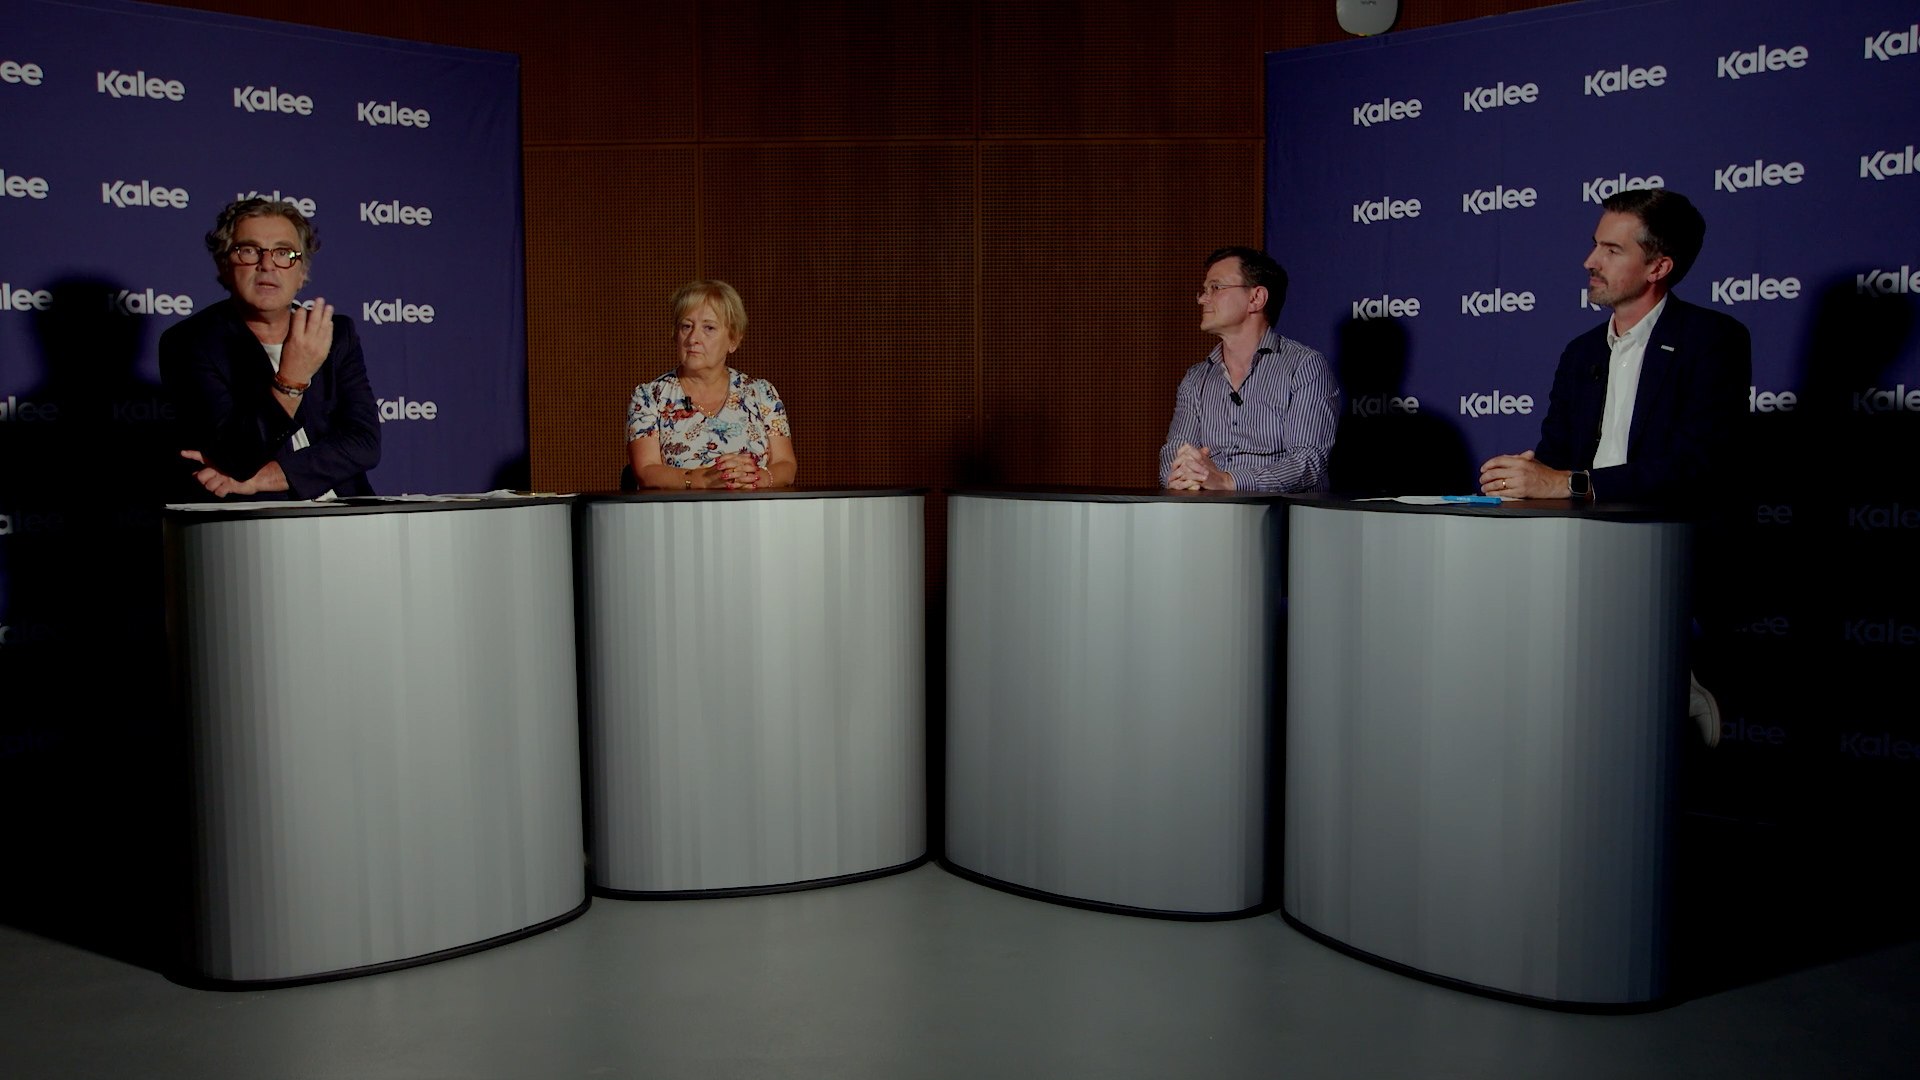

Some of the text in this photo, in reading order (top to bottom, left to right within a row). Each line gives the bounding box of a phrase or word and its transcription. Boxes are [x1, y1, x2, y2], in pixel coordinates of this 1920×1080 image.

[1864, 24, 1920, 61] Kal
[1717, 45, 1809, 80] Kalee
[97, 70, 185, 101] Kalee
[1584, 64, 1667, 97] Kalee
[233, 86, 314, 115] Kalee
[1463, 81, 1539, 112] Kalee
[357, 101, 431, 128] Kalee
[1353, 97, 1422, 127] Kalee
[1714, 159, 1805, 193] Kalee
[102, 179, 189, 209] Kalee
[1462, 185, 1538, 215] Kalee
[360, 200, 433, 226] Kalee
[1353, 196, 1422, 225] Kalee
[0, 282, 54, 312] lee
[108, 288, 194, 317] Kalee
[1461, 287, 1536, 317] Kalee
[1711, 273, 1801, 305] Kalee
[363, 298, 435, 325] Kalee
[1352, 294, 1421, 322] Kalee
[1352, 392, 1420, 418] Kalee
[1460, 390, 1534, 418] Kalee
[1844, 617, 1920, 646] Kale
